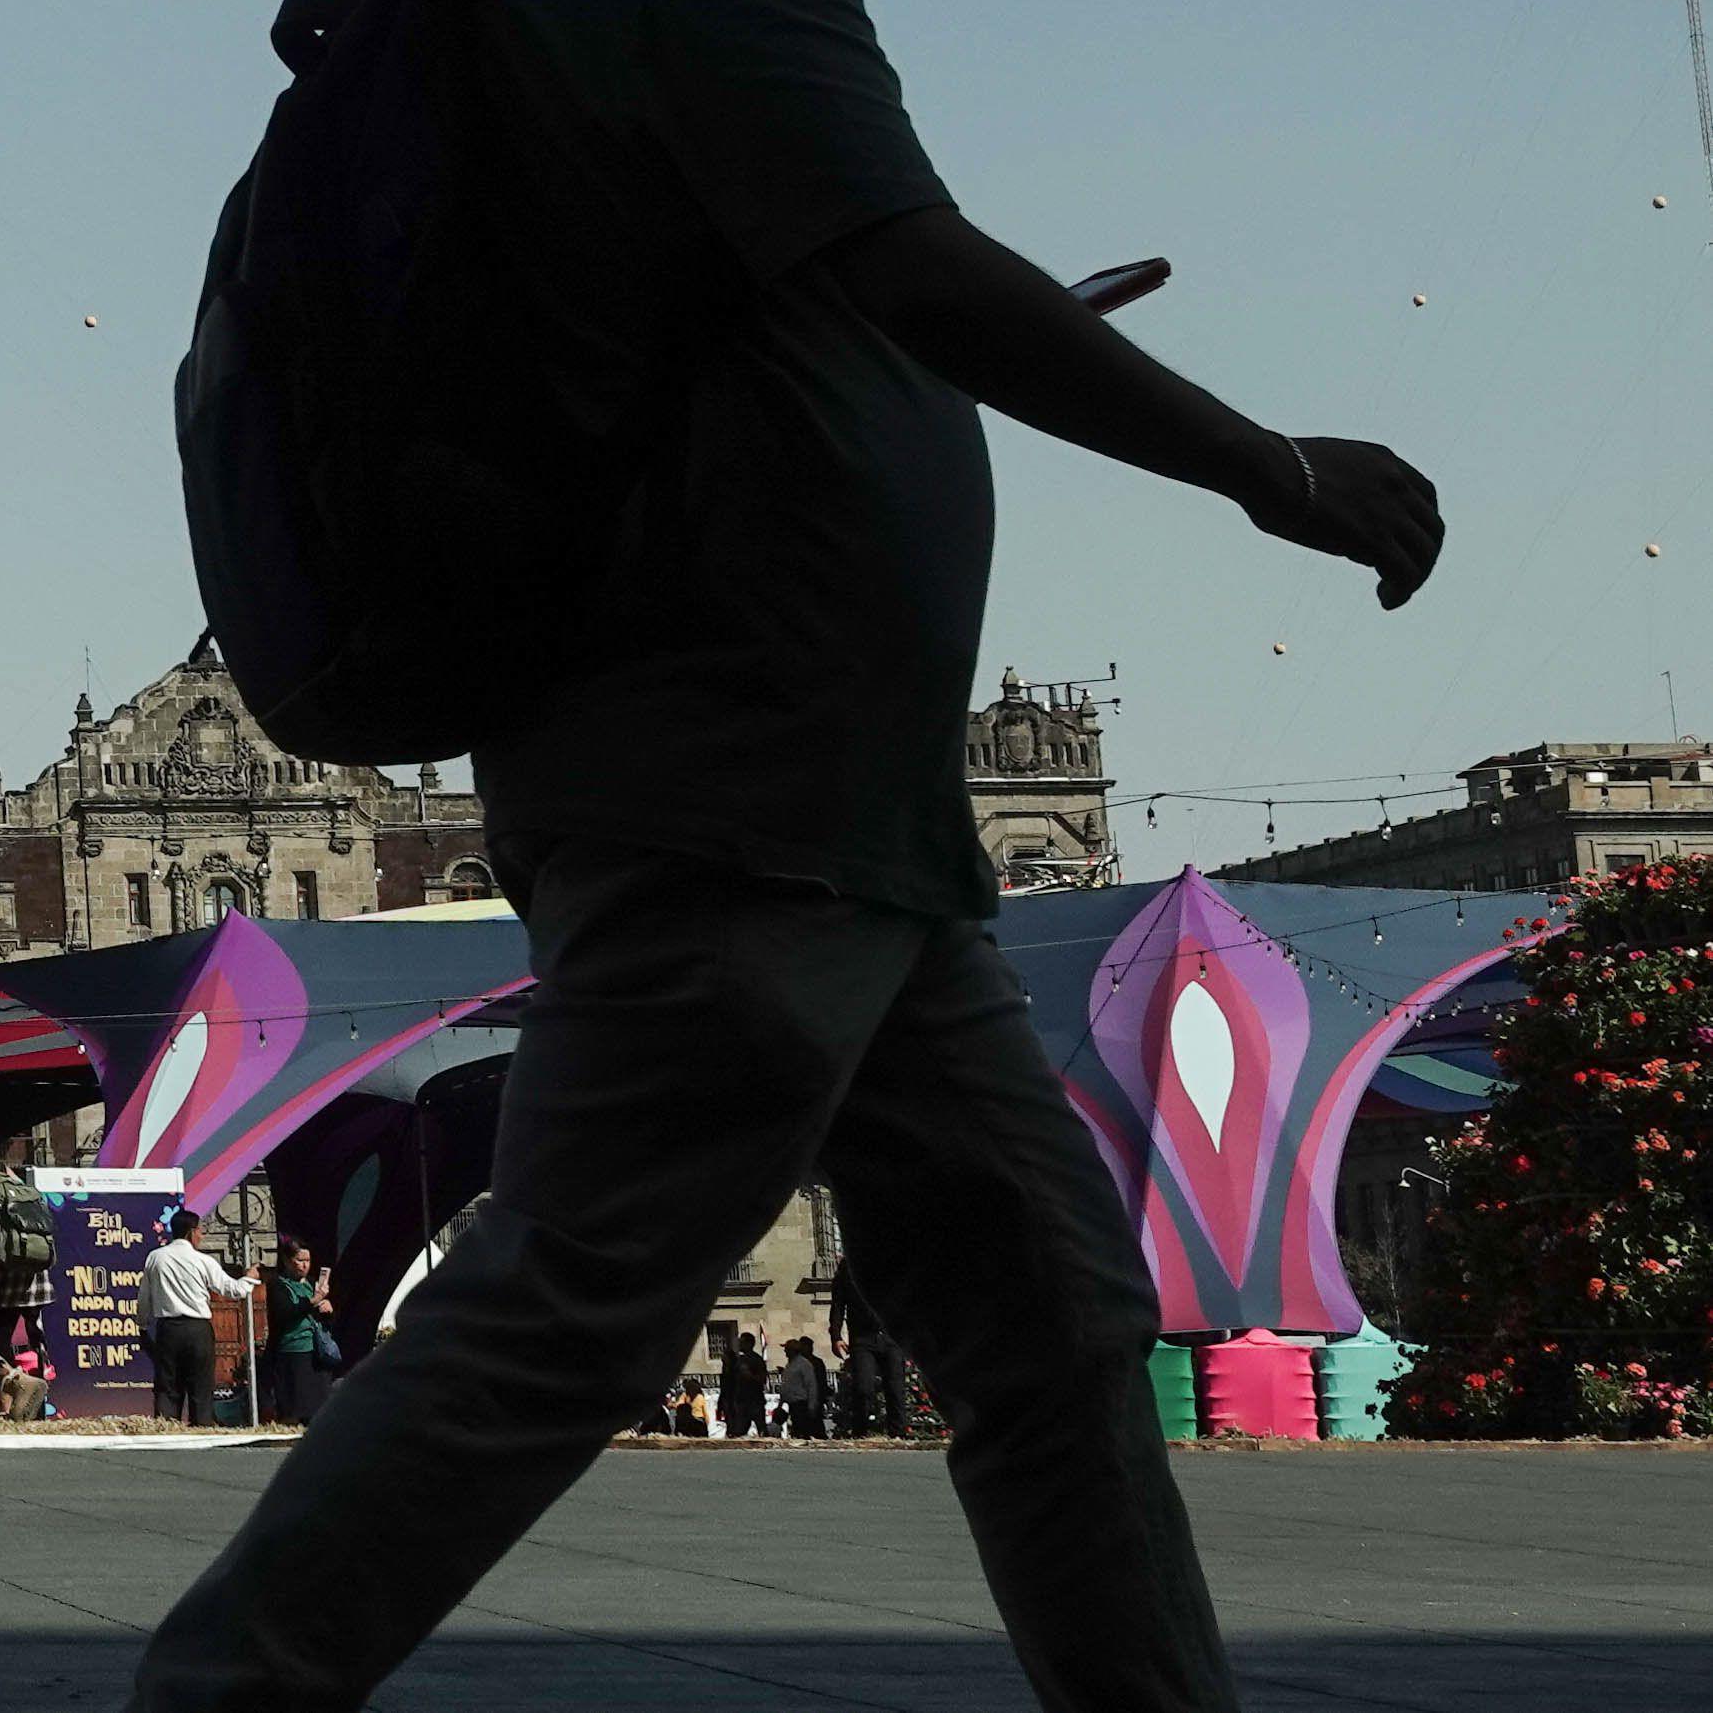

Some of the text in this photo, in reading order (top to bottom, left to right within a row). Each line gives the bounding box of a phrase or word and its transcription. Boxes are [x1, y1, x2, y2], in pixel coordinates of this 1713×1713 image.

[111, 1271, 144, 1287] HAY
[71, 1296, 114, 1311] NADA
[78, 1345, 102, 1368] EN
